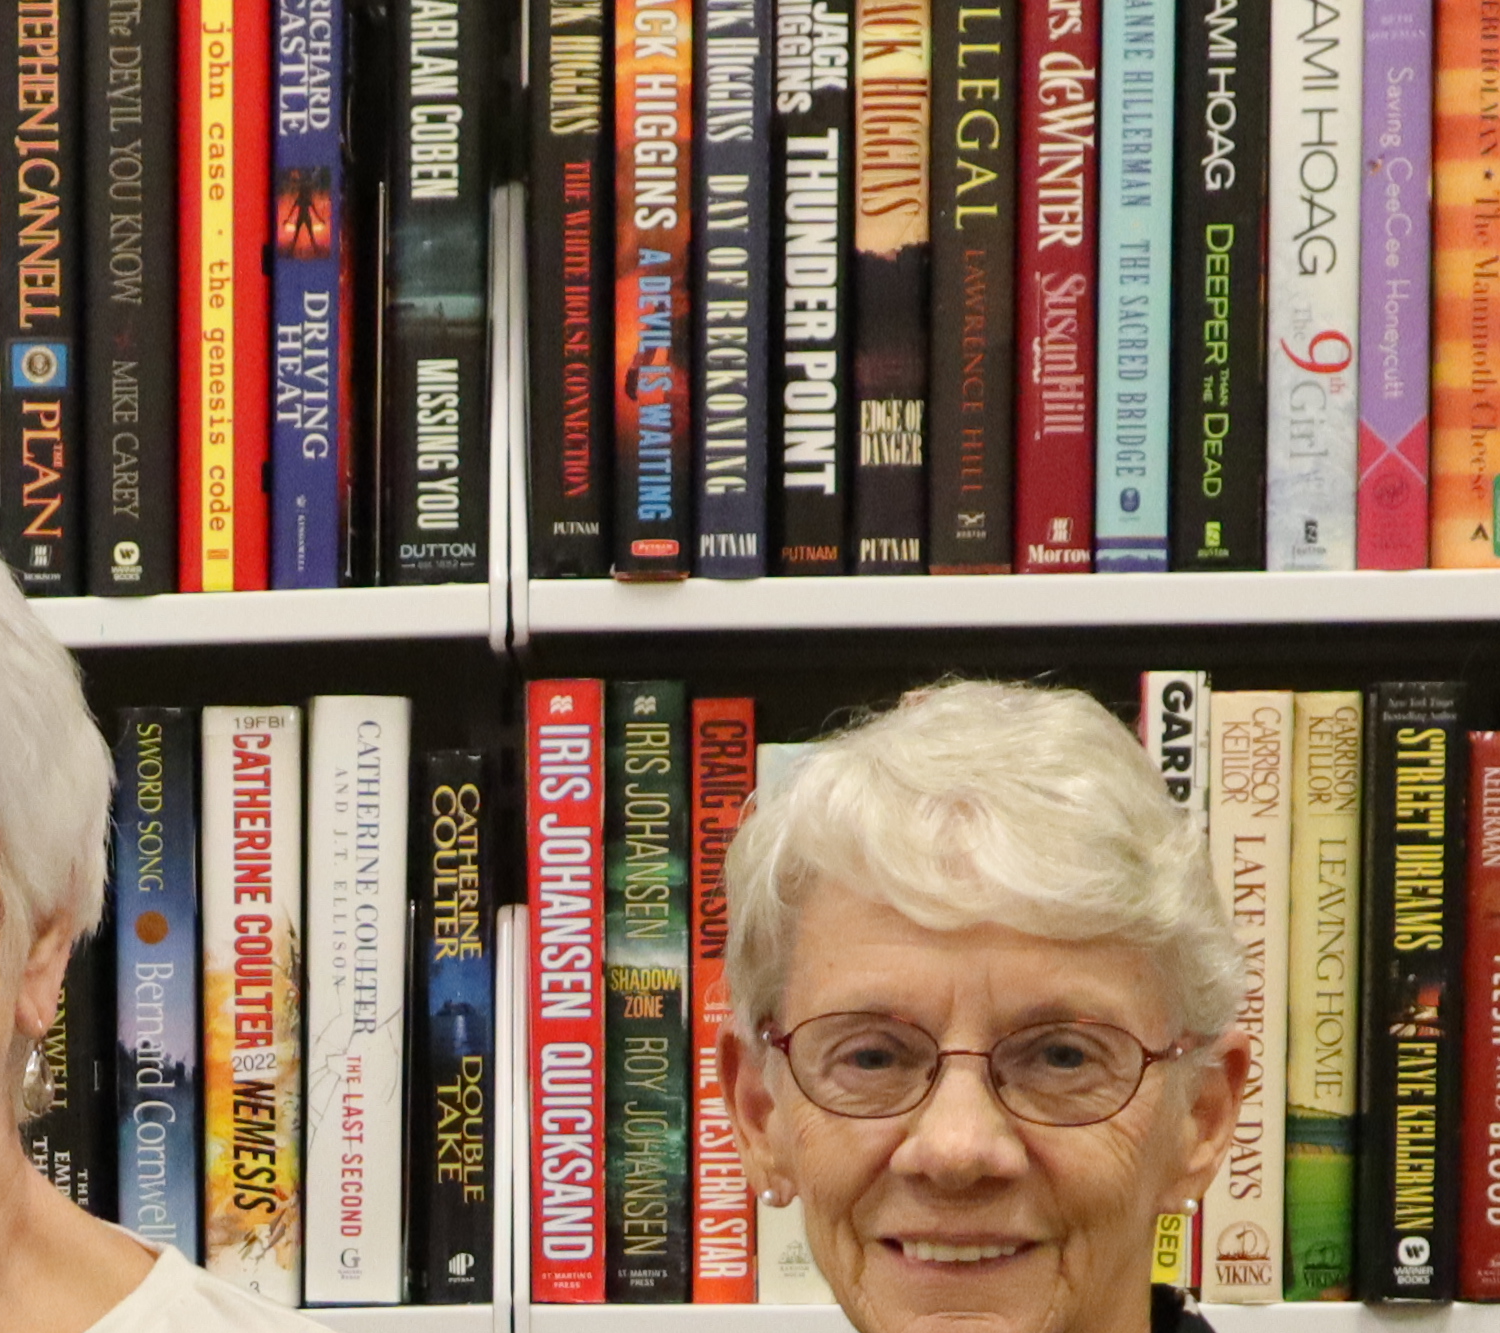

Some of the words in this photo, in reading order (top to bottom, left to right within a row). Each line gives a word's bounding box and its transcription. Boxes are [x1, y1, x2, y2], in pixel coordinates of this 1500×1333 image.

[202, 20, 234, 100] john
[209, 122, 226, 201] case
[411, 103, 459, 200] COBEN
[208, 259, 226, 311] the
[784, 128, 839, 342] THUNDER
[203, 326, 231, 445] genesis
[276, 323, 300, 429] HEAT
[301, 291, 330, 461] DRIVING
[416, 358, 459, 473] MISSING
[782, 351, 836, 494] POINT
[206, 464, 226, 532] code
[400, 542, 476, 558] DUTTON
[418, 479, 459, 531] YOU
[134, 722, 166, 815] SWORD
[538, 724, 591, 802] IRIS
[1394, 726, 1446, 836] STREET
[138, 818, 167, 893] SONG
[231, 731, 274, 904] CATHERINE
[538, 812, 592, 1019] JOHANSEN
[1392, 843, 1445, 952] DREAMS
[231, 913, 274, 1050] COULTER
[231, 1053, 277, 1072] 2022
[232, 1078, 276, 1215] NEMESIS
[538, 1041, 592, 1261] QUICKSAND
[1216, 1266, 1272, 1285] VIKING
